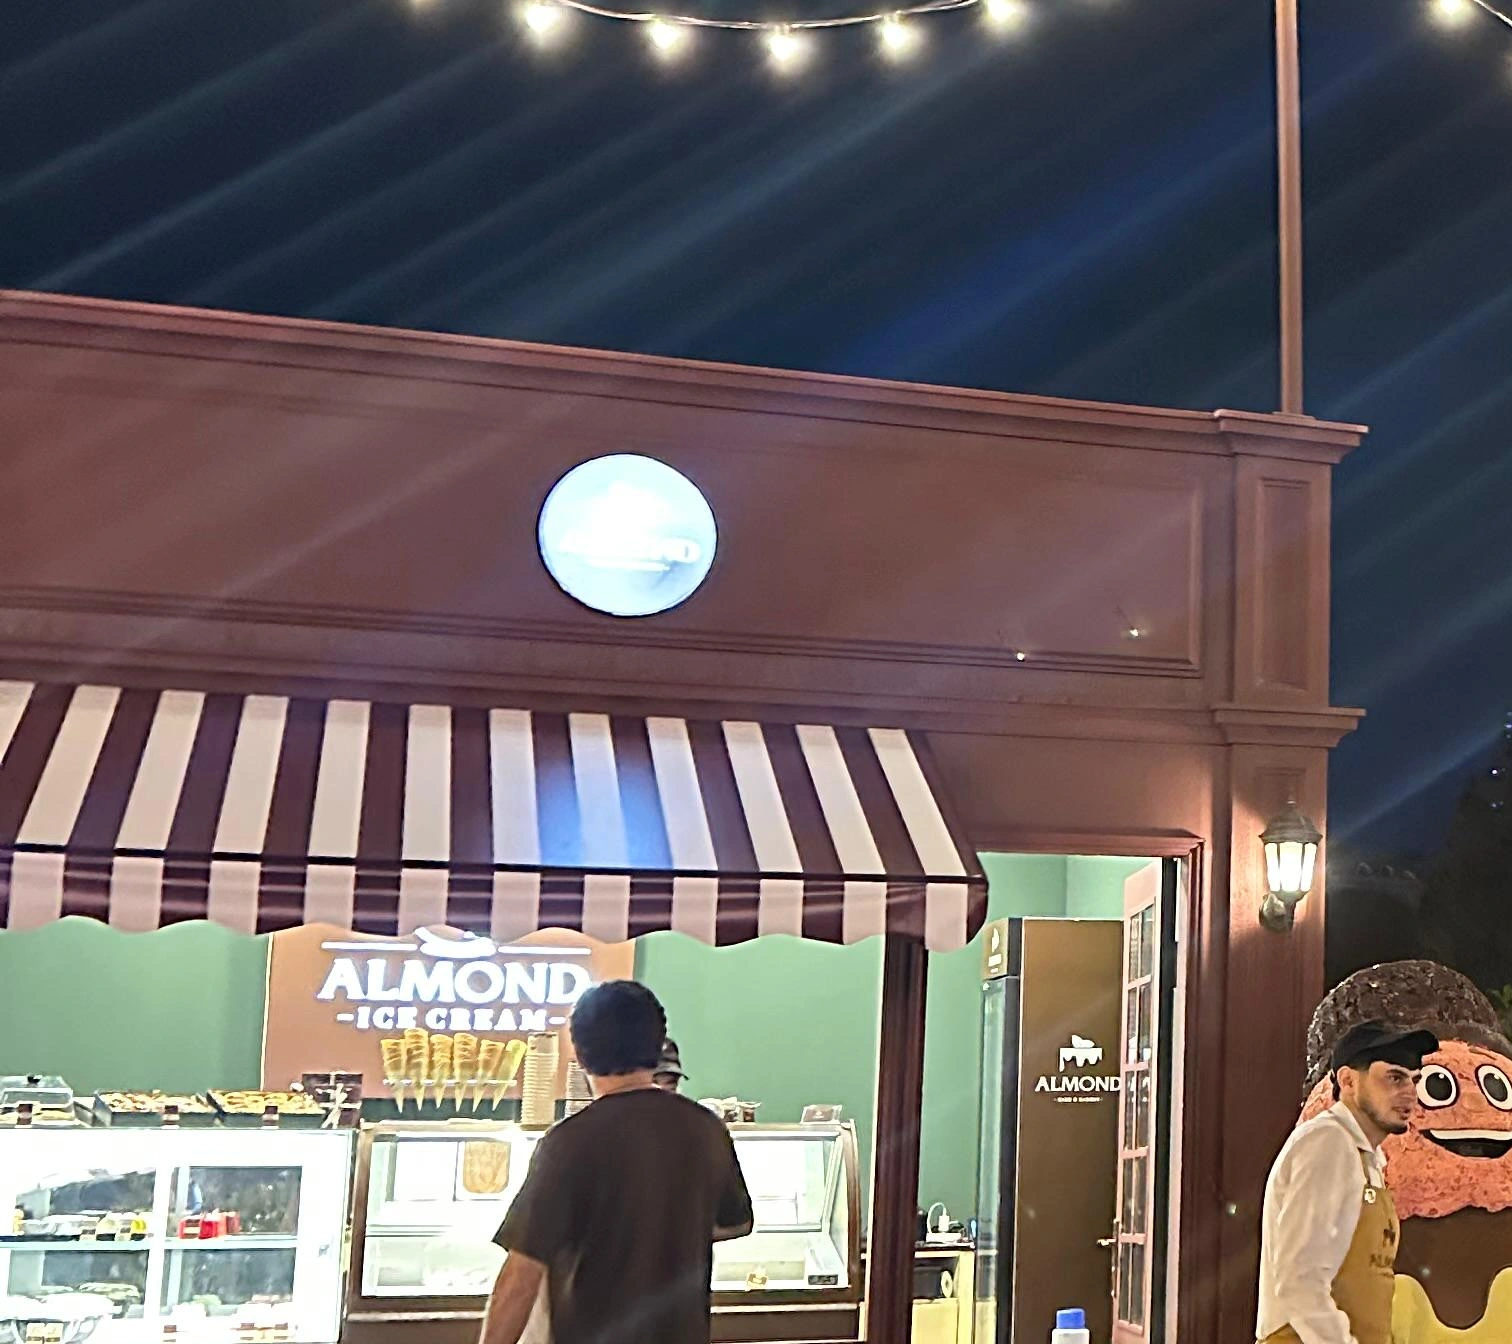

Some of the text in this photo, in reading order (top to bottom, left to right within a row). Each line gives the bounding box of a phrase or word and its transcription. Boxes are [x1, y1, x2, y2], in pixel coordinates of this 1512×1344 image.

[316, 957, 592, 1004] ALMOND
[356, 1006, 548, 1031] ICE CREAM
[1034, 1076, 1121, 1092] ALMOND
